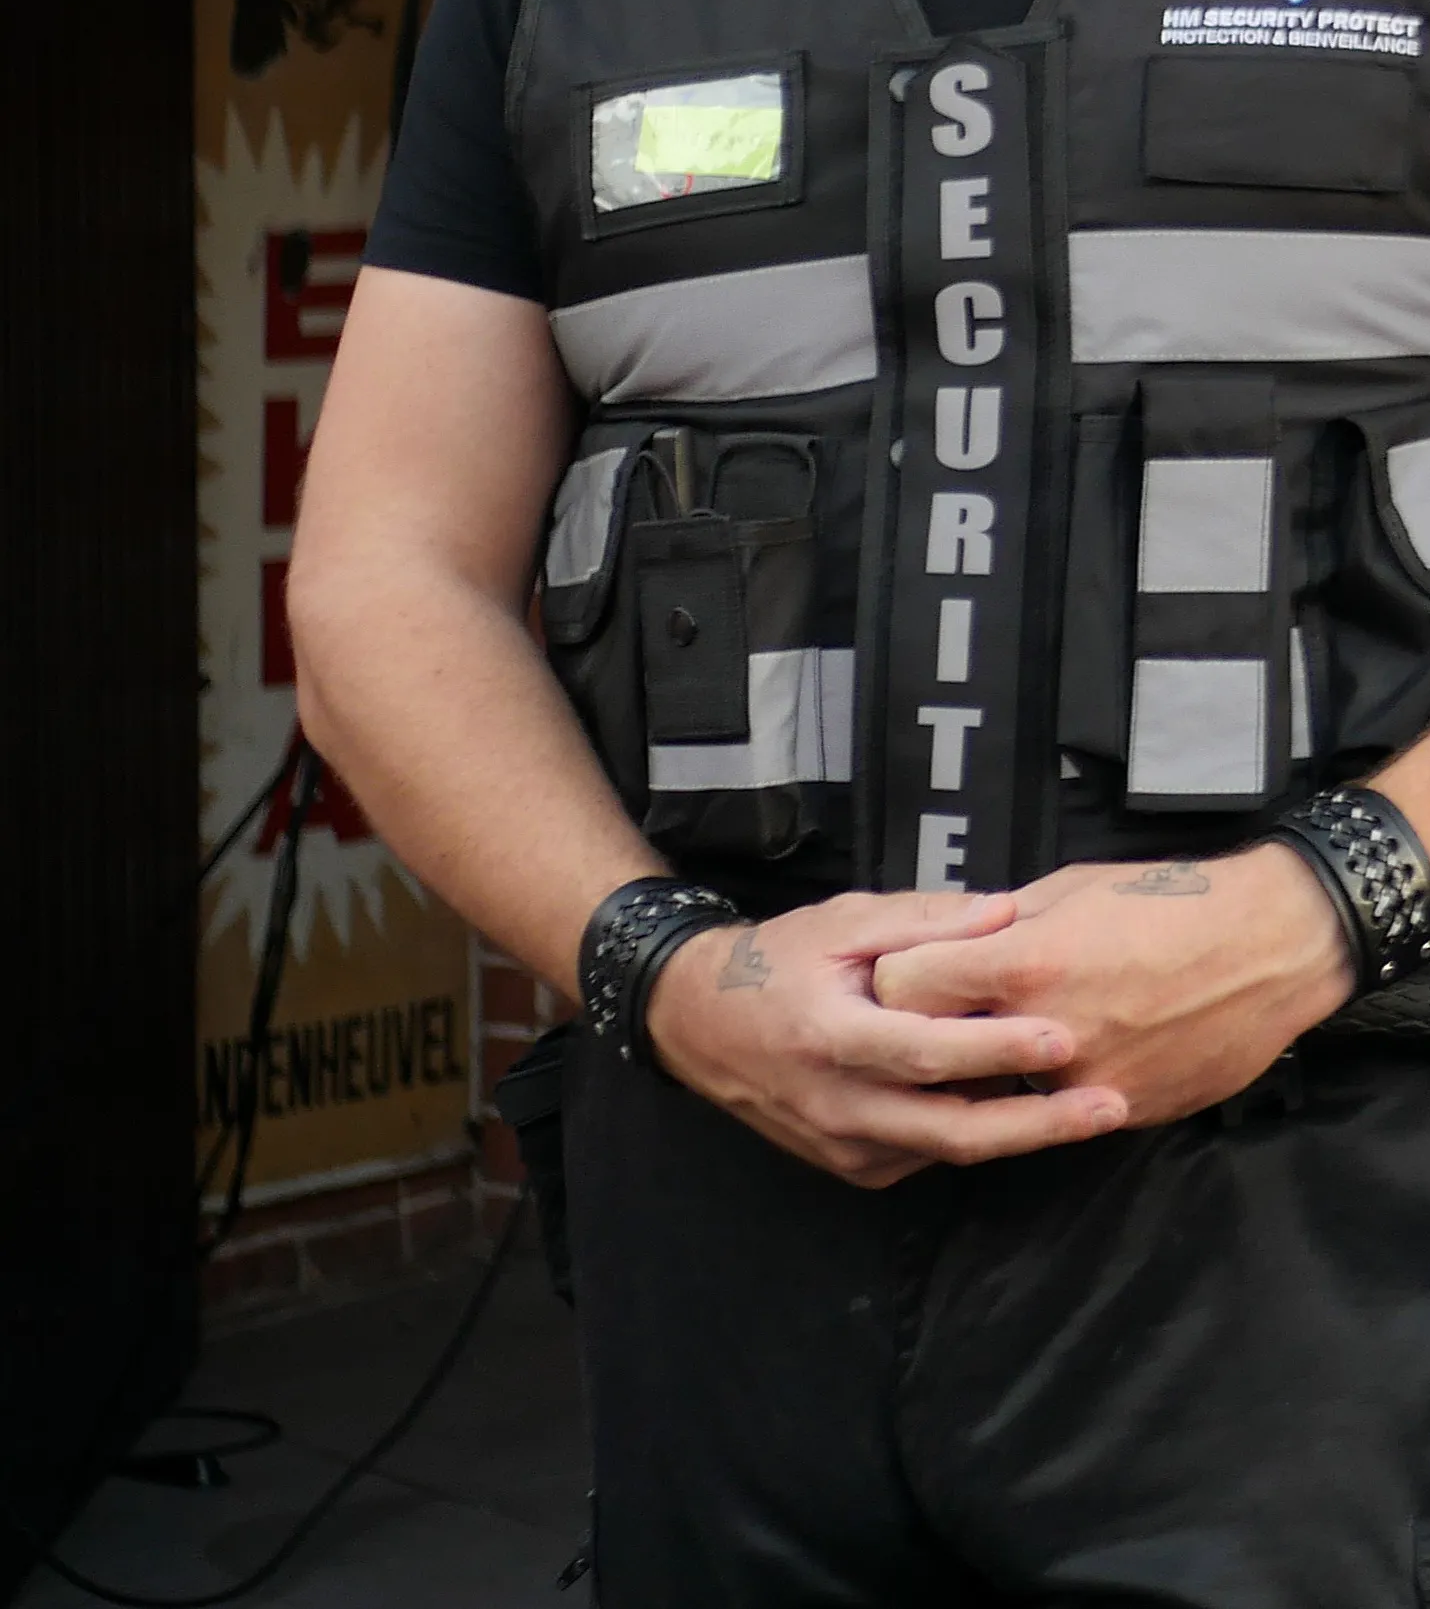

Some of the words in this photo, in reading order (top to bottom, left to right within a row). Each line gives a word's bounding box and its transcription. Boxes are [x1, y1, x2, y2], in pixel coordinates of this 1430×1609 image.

[1163, 8, 1199, 27] HM
[1202, 8, 1316, 29] SECURITY
[1317, 10, 1421, 37] PROTECT
[1161, 29, 1270, 45] PROTECTION
[1271, 33, 1286, 46] &
[1288, 32, 1421, 56] BIENVEILLANCE
[916, 61, 1005, 893] SECURITE
